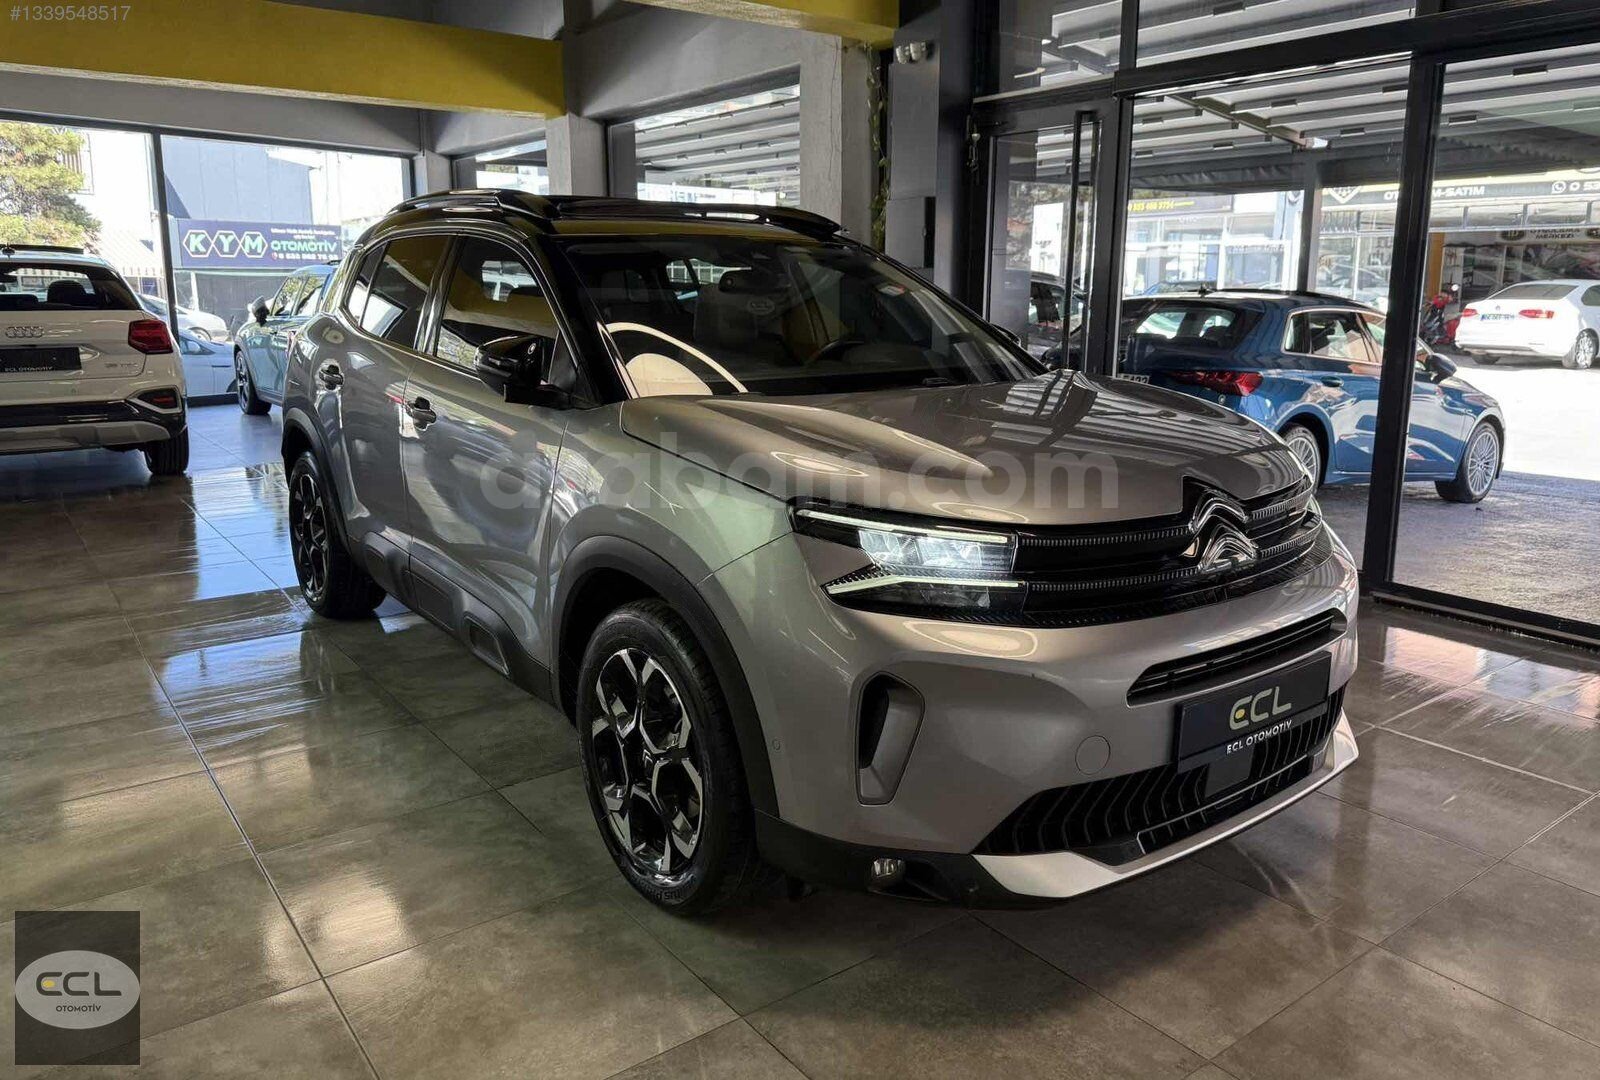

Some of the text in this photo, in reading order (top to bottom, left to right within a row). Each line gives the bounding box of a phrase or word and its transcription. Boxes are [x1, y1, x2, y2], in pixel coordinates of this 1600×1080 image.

[1432, 186, 1486, 199] M-SATIM
[189, 233, 263, 254] KYM
[1229, 686, 1292, 731] ECL
[1226, 740, 1244, 755] ECL
